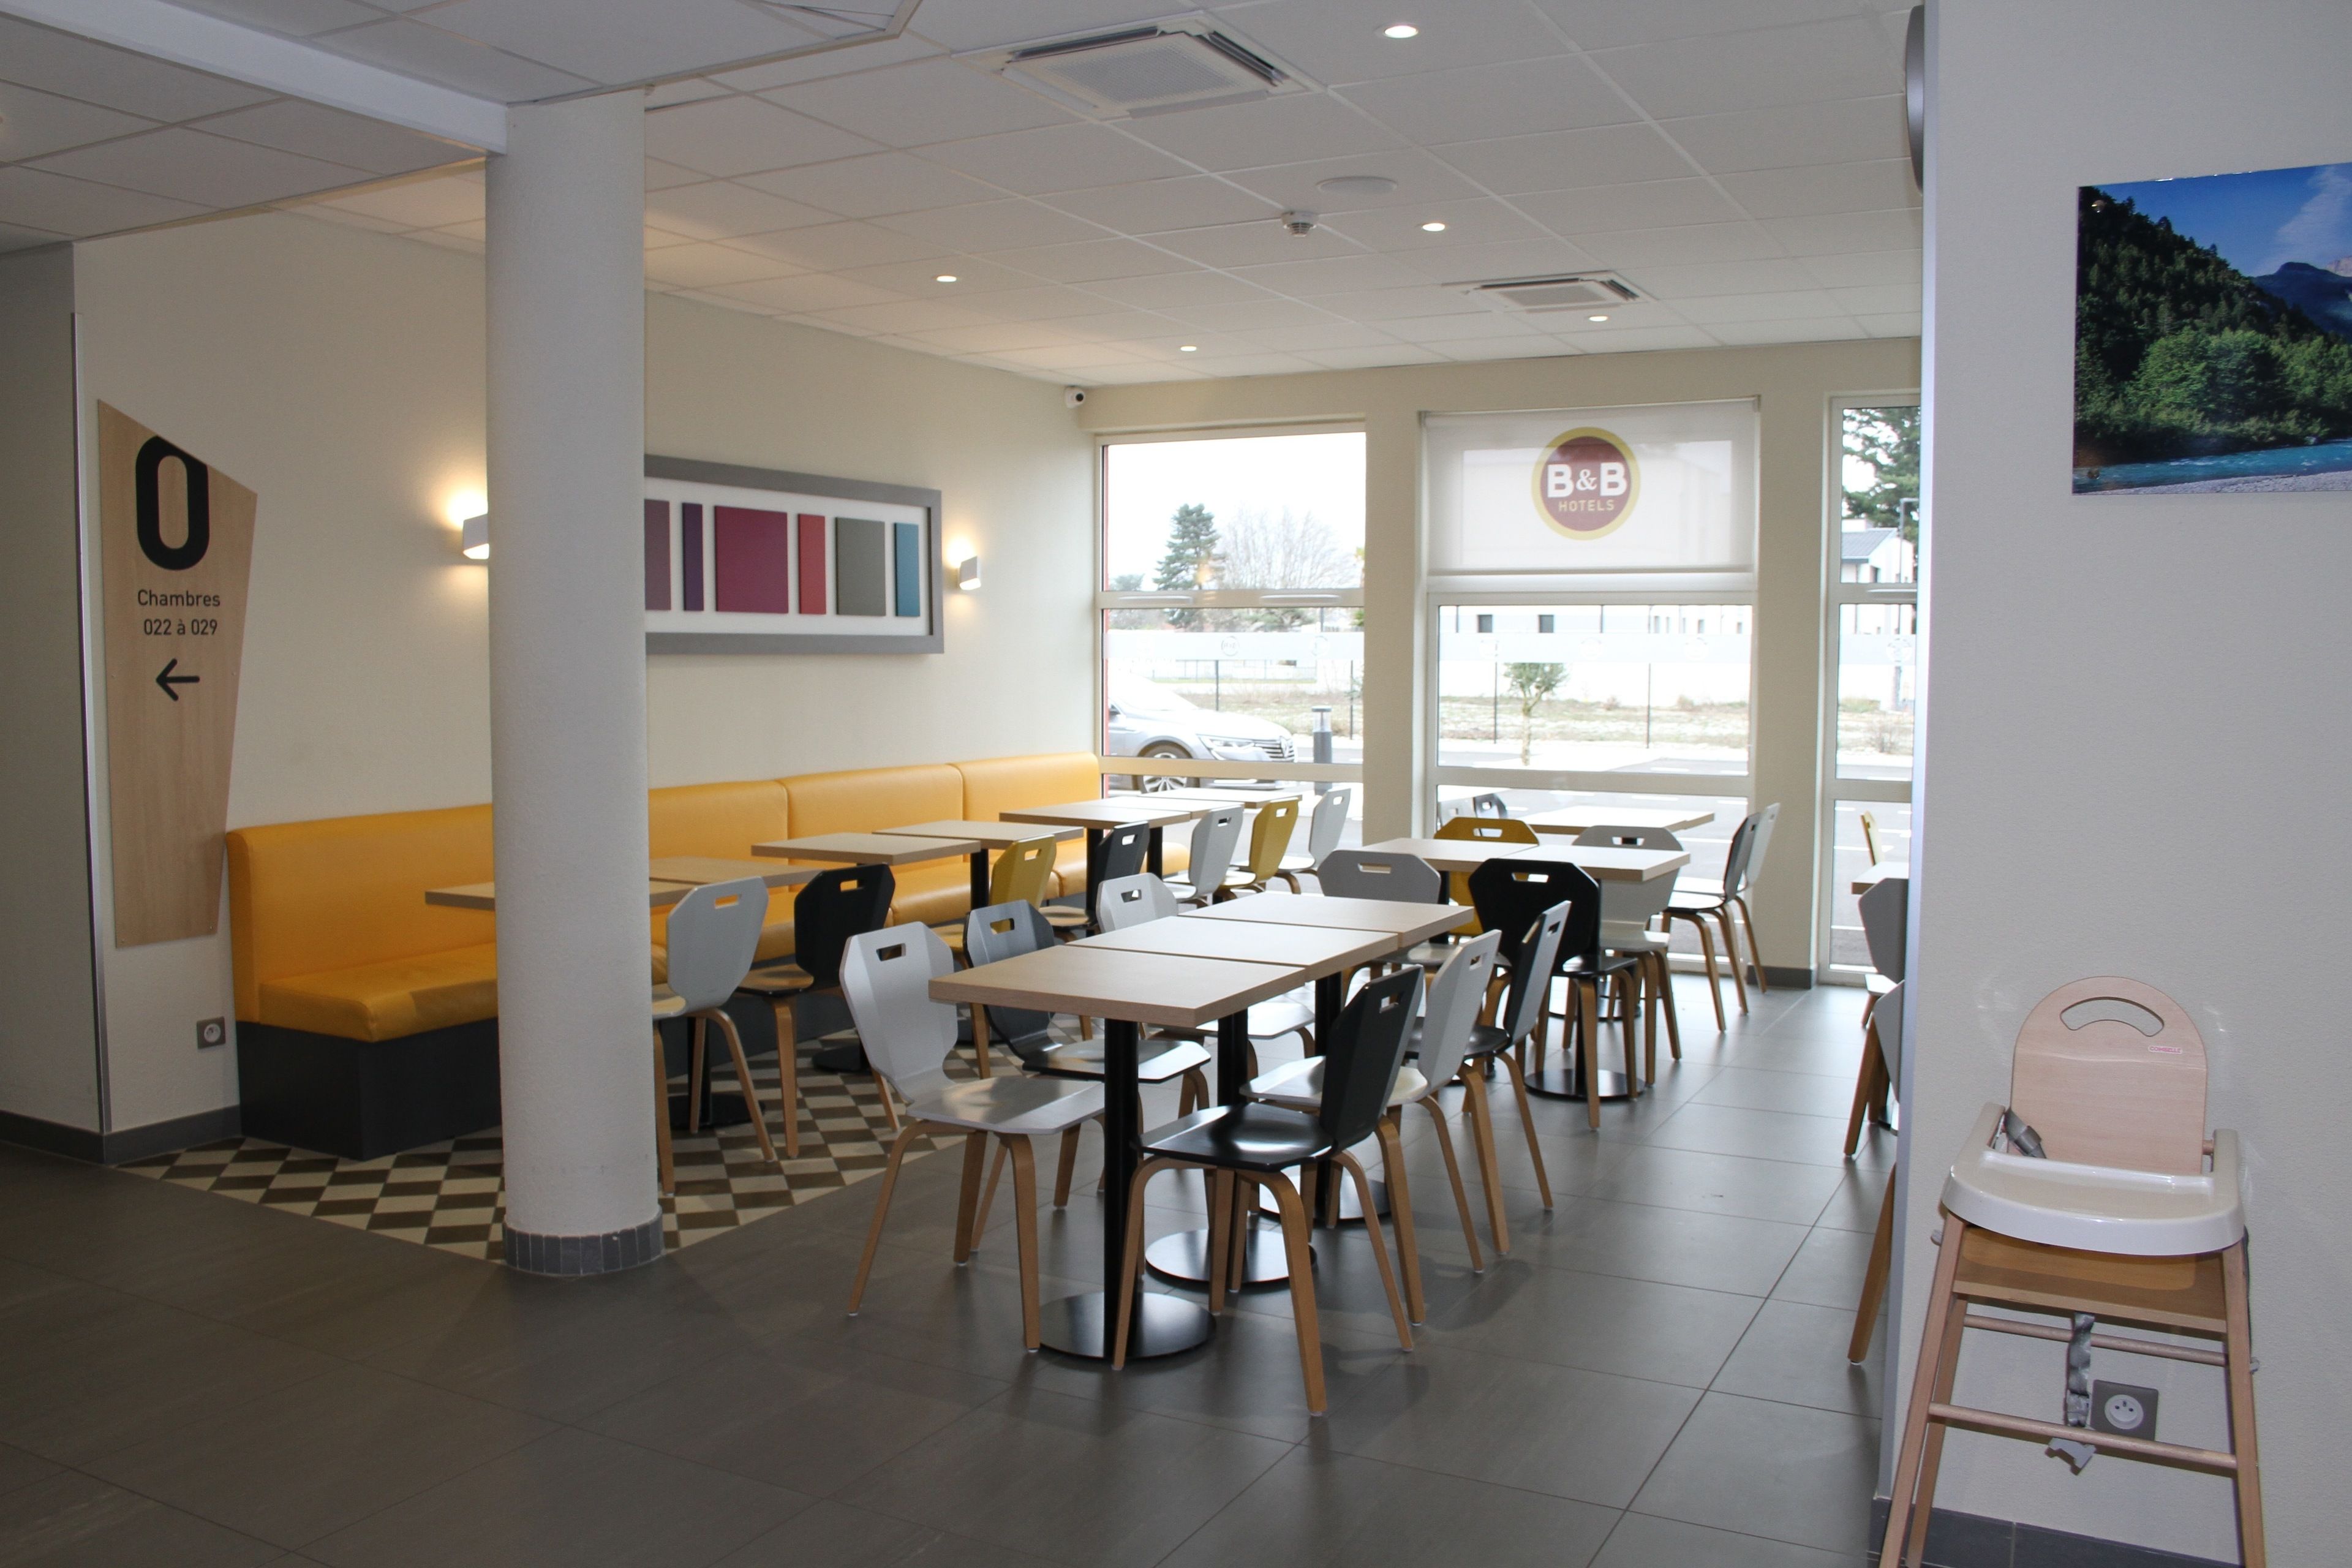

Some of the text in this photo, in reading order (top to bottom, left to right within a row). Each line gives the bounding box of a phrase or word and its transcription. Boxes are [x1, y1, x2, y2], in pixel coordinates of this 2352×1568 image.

[1547, 462, 1627, 498] B&B
[135, 435, 209, 570] 0
[1558, 499, 1615, 512] HOTELS
[137, 589, 221, 607] Chambres
[143, 618, 218, 636] 022 à 029
